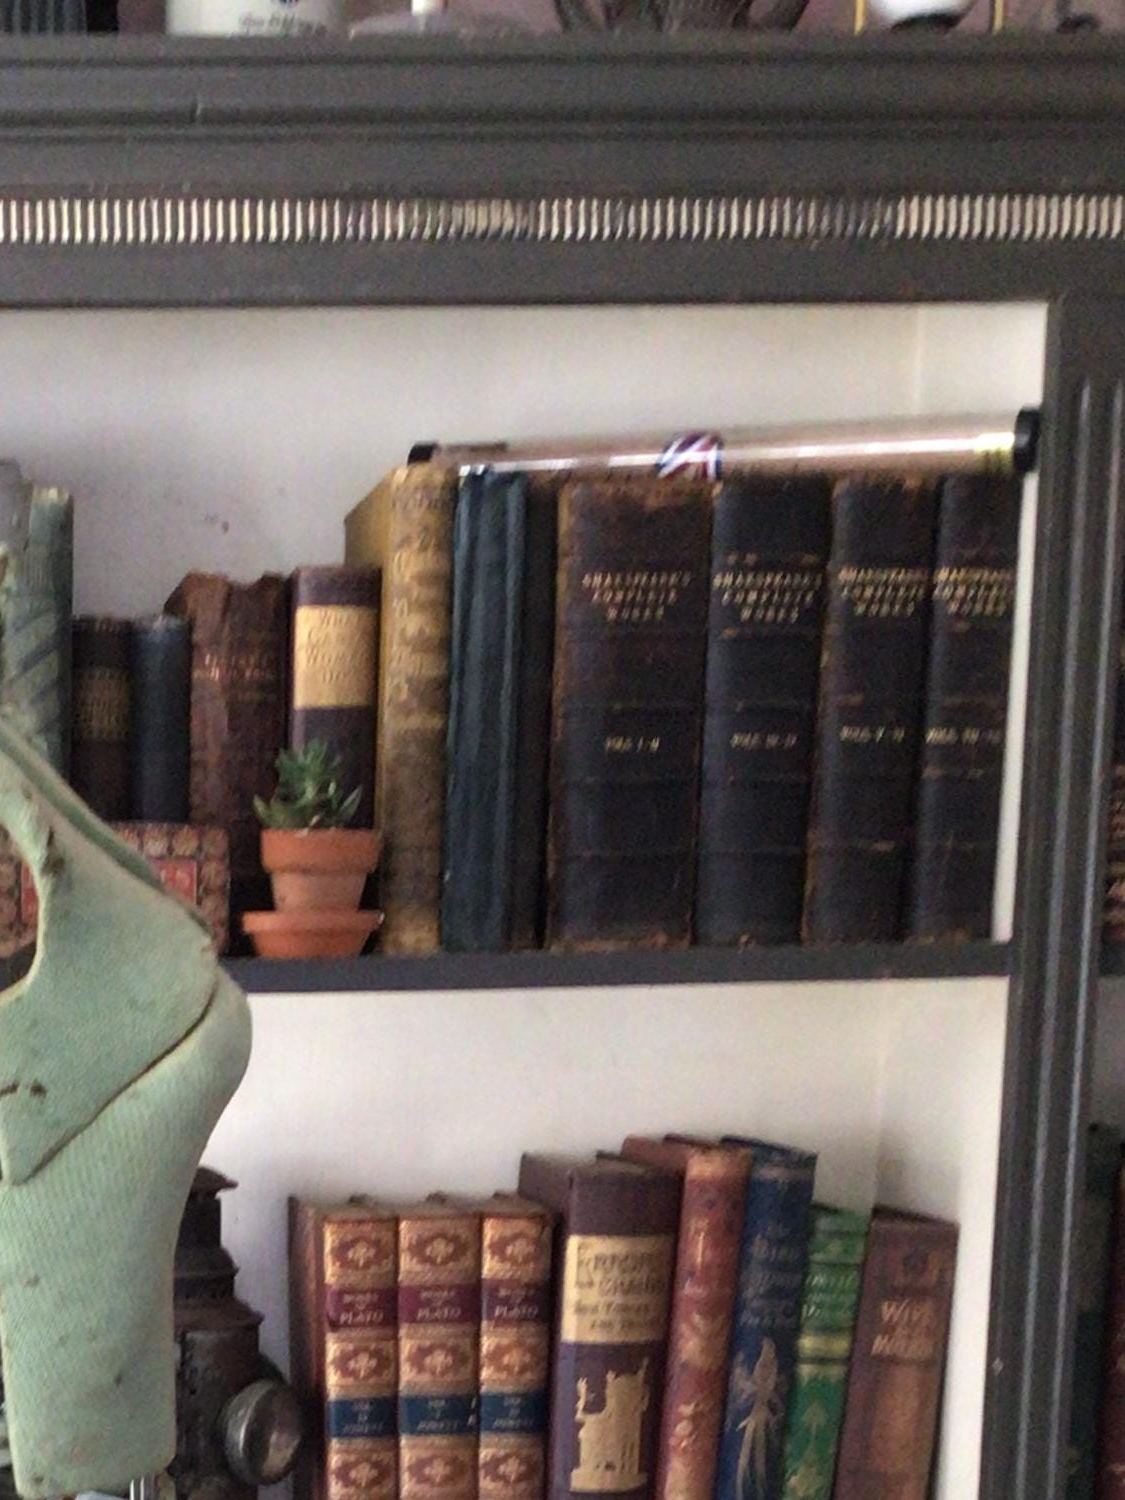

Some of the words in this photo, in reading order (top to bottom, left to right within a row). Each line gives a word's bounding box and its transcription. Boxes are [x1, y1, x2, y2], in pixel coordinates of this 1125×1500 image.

[339, 1310, 384, 1324] PLATO
[417, 1306, 463, 1321] PLATO
[494, 1304, 540, 1319] PLATO
